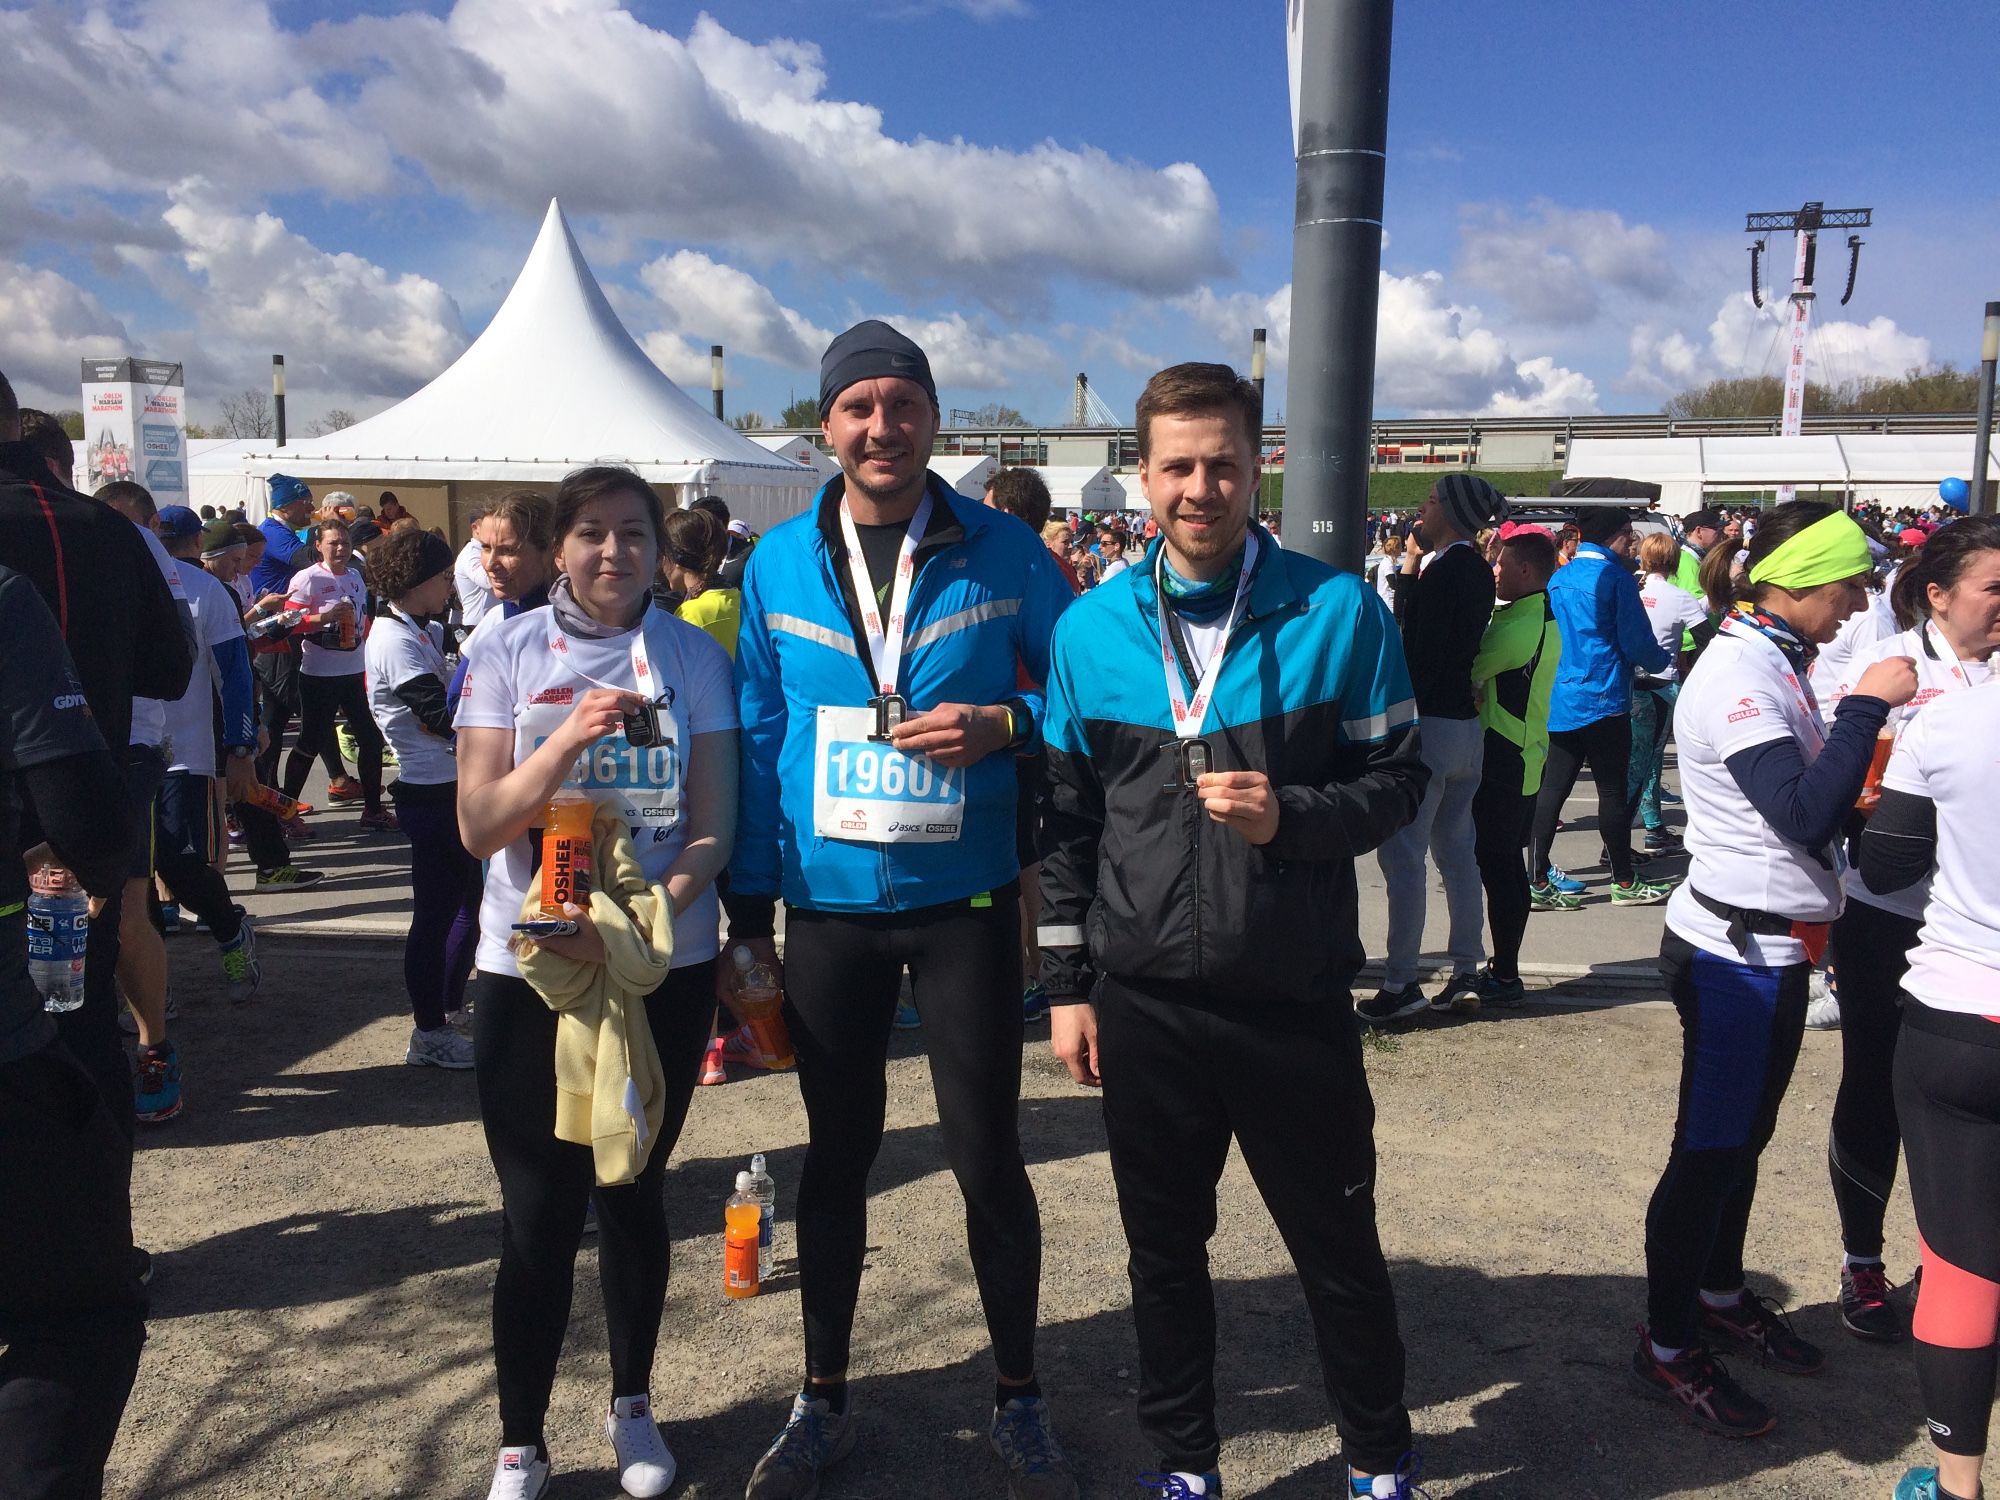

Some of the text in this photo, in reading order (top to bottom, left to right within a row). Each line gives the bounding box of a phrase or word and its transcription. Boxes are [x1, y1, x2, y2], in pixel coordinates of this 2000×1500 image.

[144, 406, 177, 414] MARATHON
[1312, 520, 1333, 533] 515
[543, 687, 574, 696] ORLEN
[1729, 708, 1759, 722] ORLEN
[830, 748, 957, 798] 19607
[841, 821, 865, 830] ORLEN
[927, 824, 957, 833] OSHEE
[554, 838, 571, 904] OSHEE
